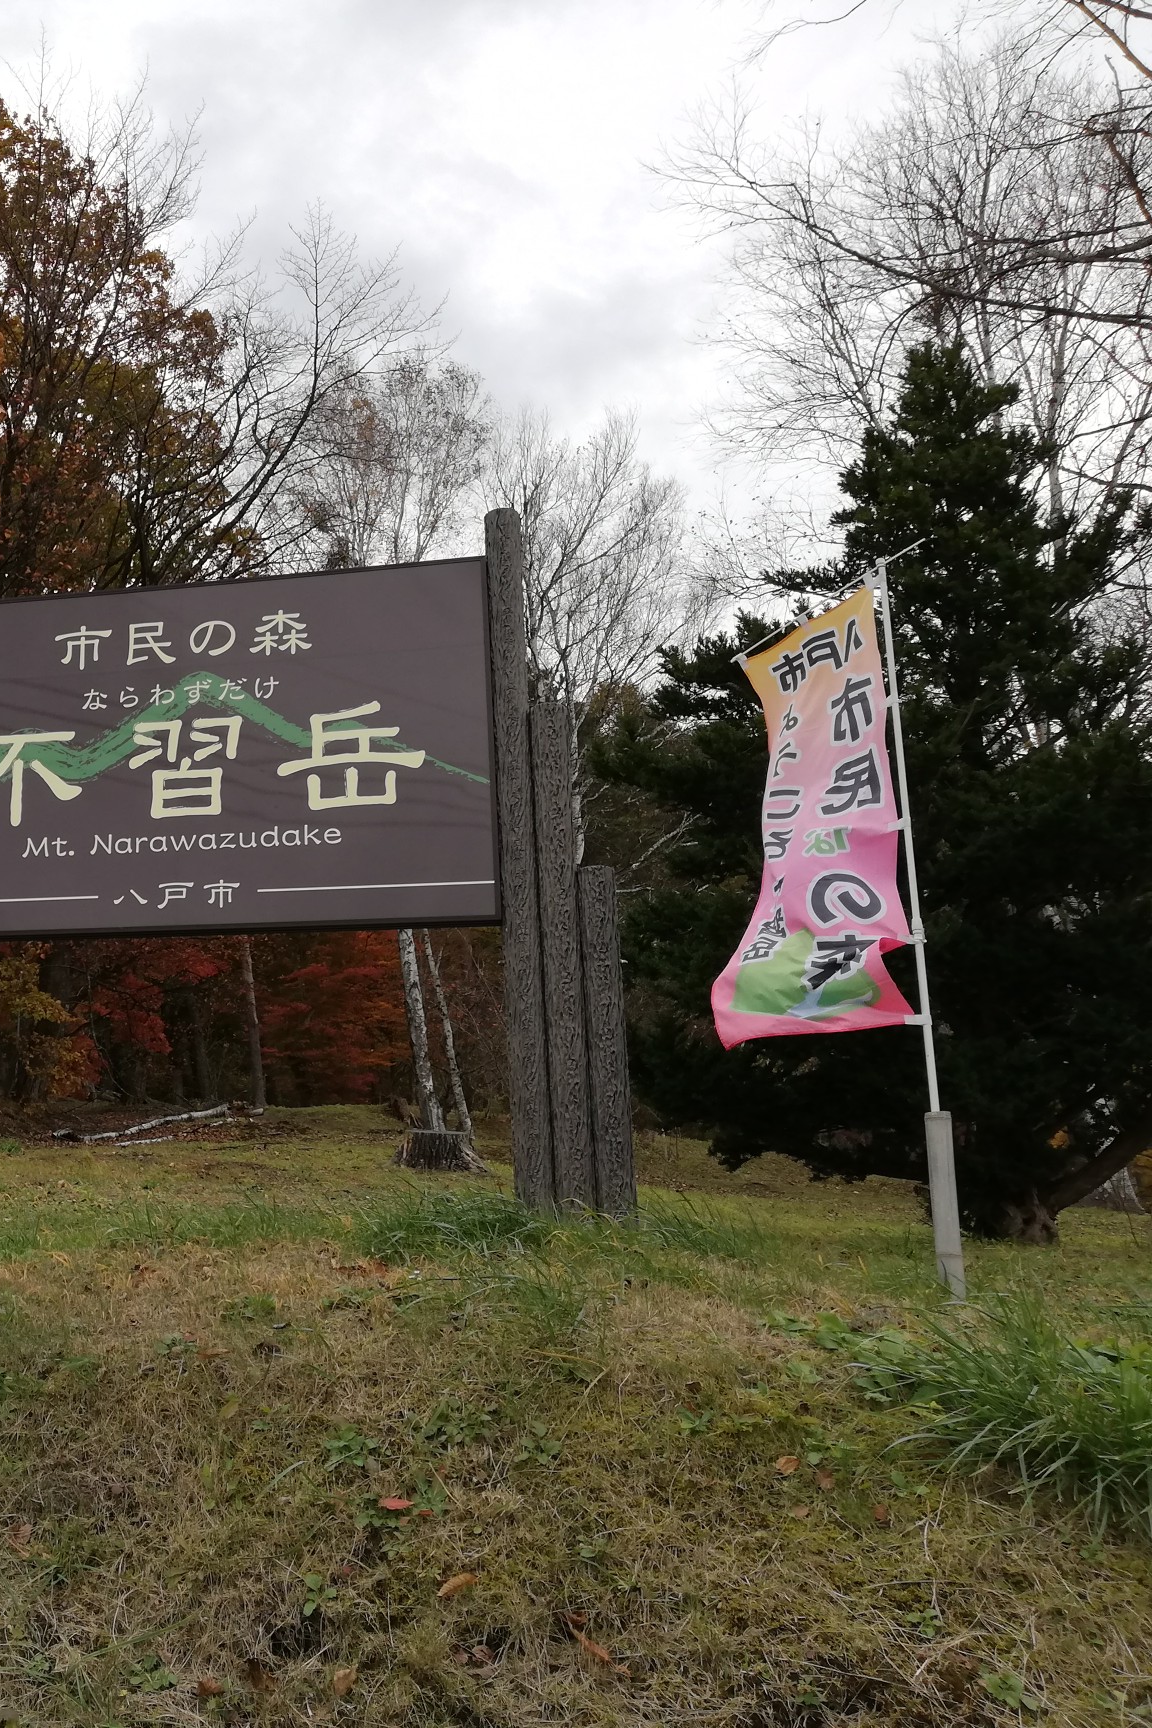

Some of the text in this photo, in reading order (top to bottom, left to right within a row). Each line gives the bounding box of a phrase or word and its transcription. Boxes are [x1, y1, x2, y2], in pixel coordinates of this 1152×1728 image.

[54, 609, 313, 670] 市民の森
[81, 675, 280, 711] ならわずだけ
[22, 825, 342, 859] Mt. Narawazudake
[113, 879, 240, 909] 八戸市
